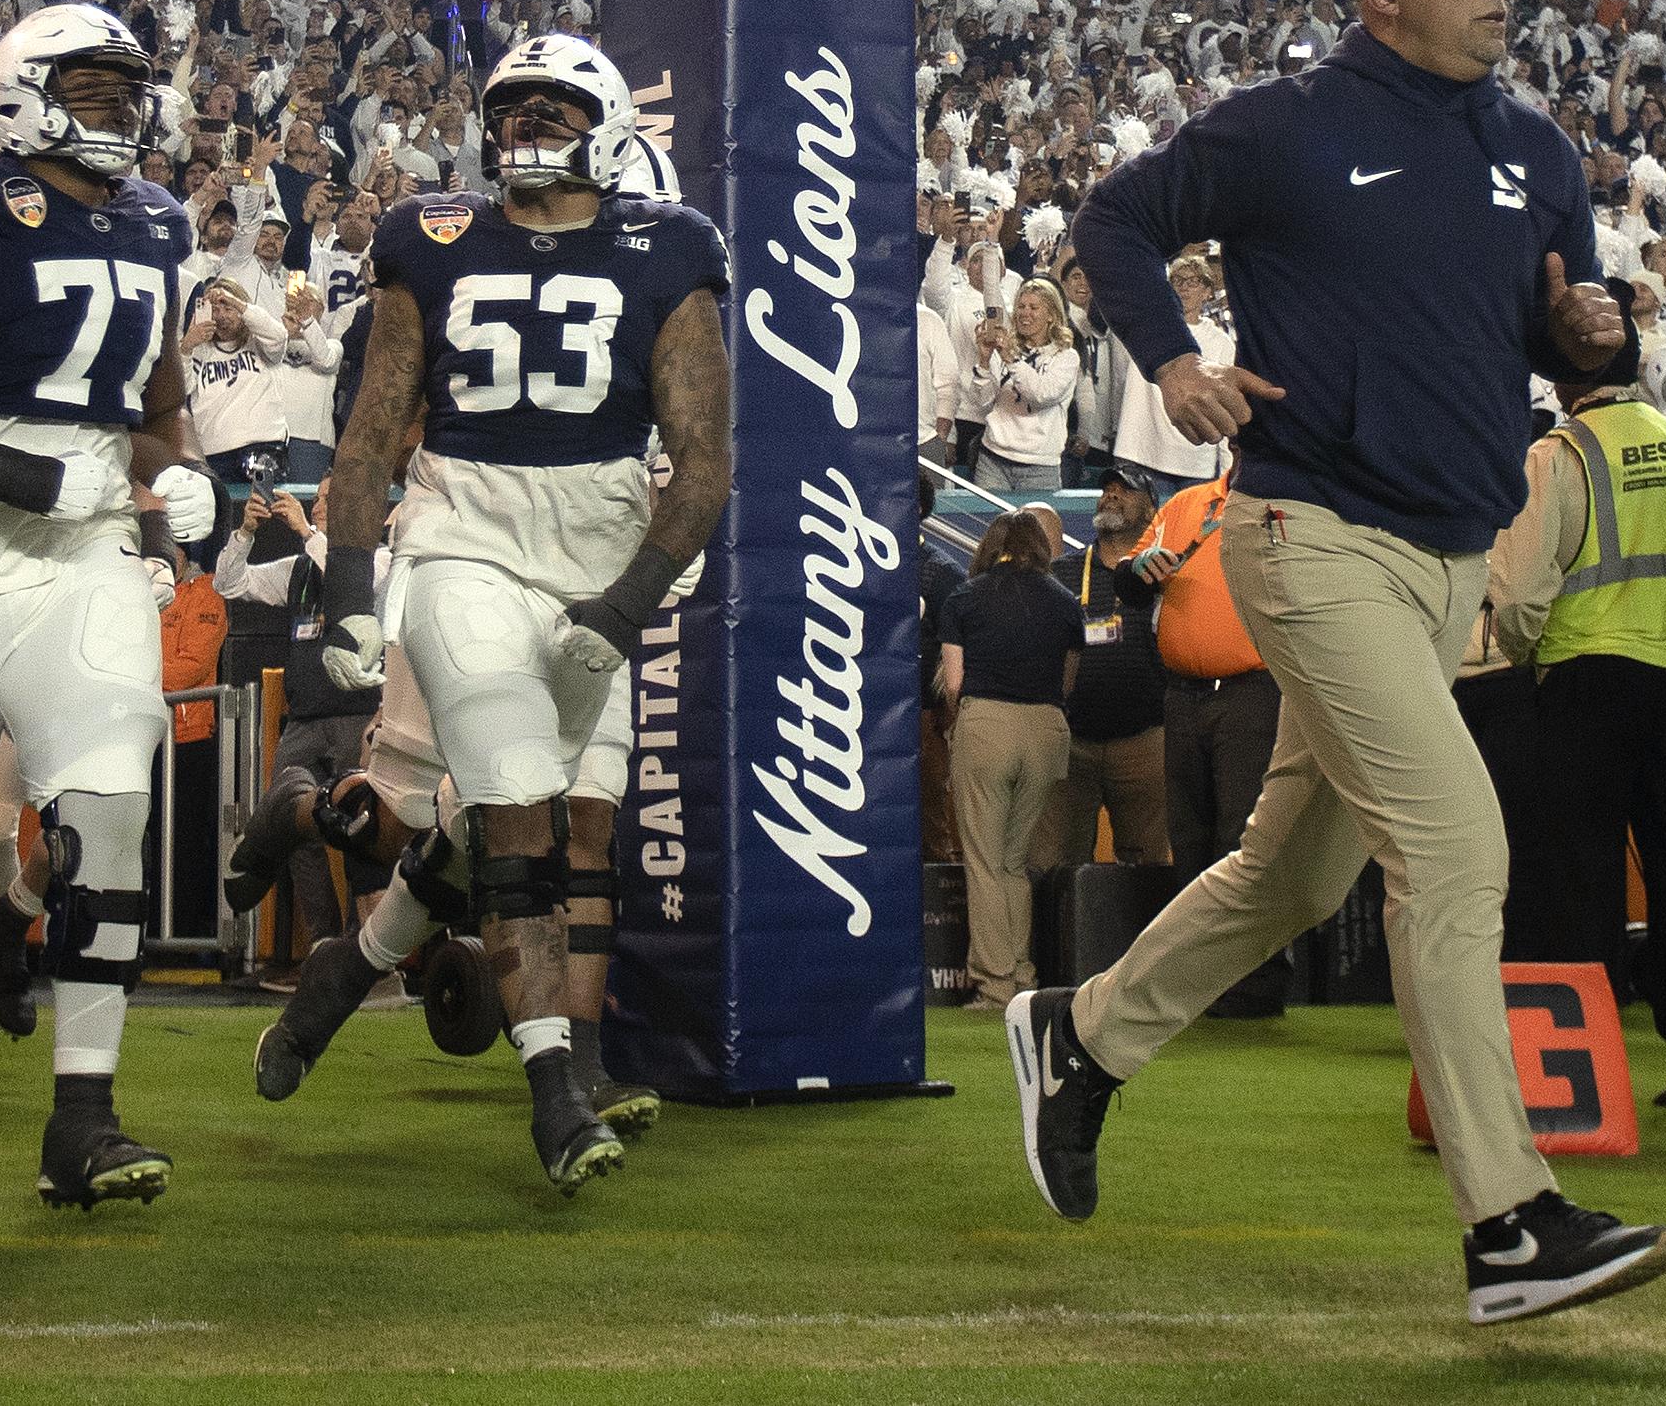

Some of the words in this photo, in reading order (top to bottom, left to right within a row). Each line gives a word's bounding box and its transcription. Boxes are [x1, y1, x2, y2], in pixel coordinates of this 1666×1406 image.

[744, 44, 864, 431] Lions
[32, 258, 166, 413] 77
[200, 361, 228, 387] PENN
[445, 273, 624, 415] 53
[751, 465, 902, 940] Nittany
[1503, 983, 1603, 1134] G
